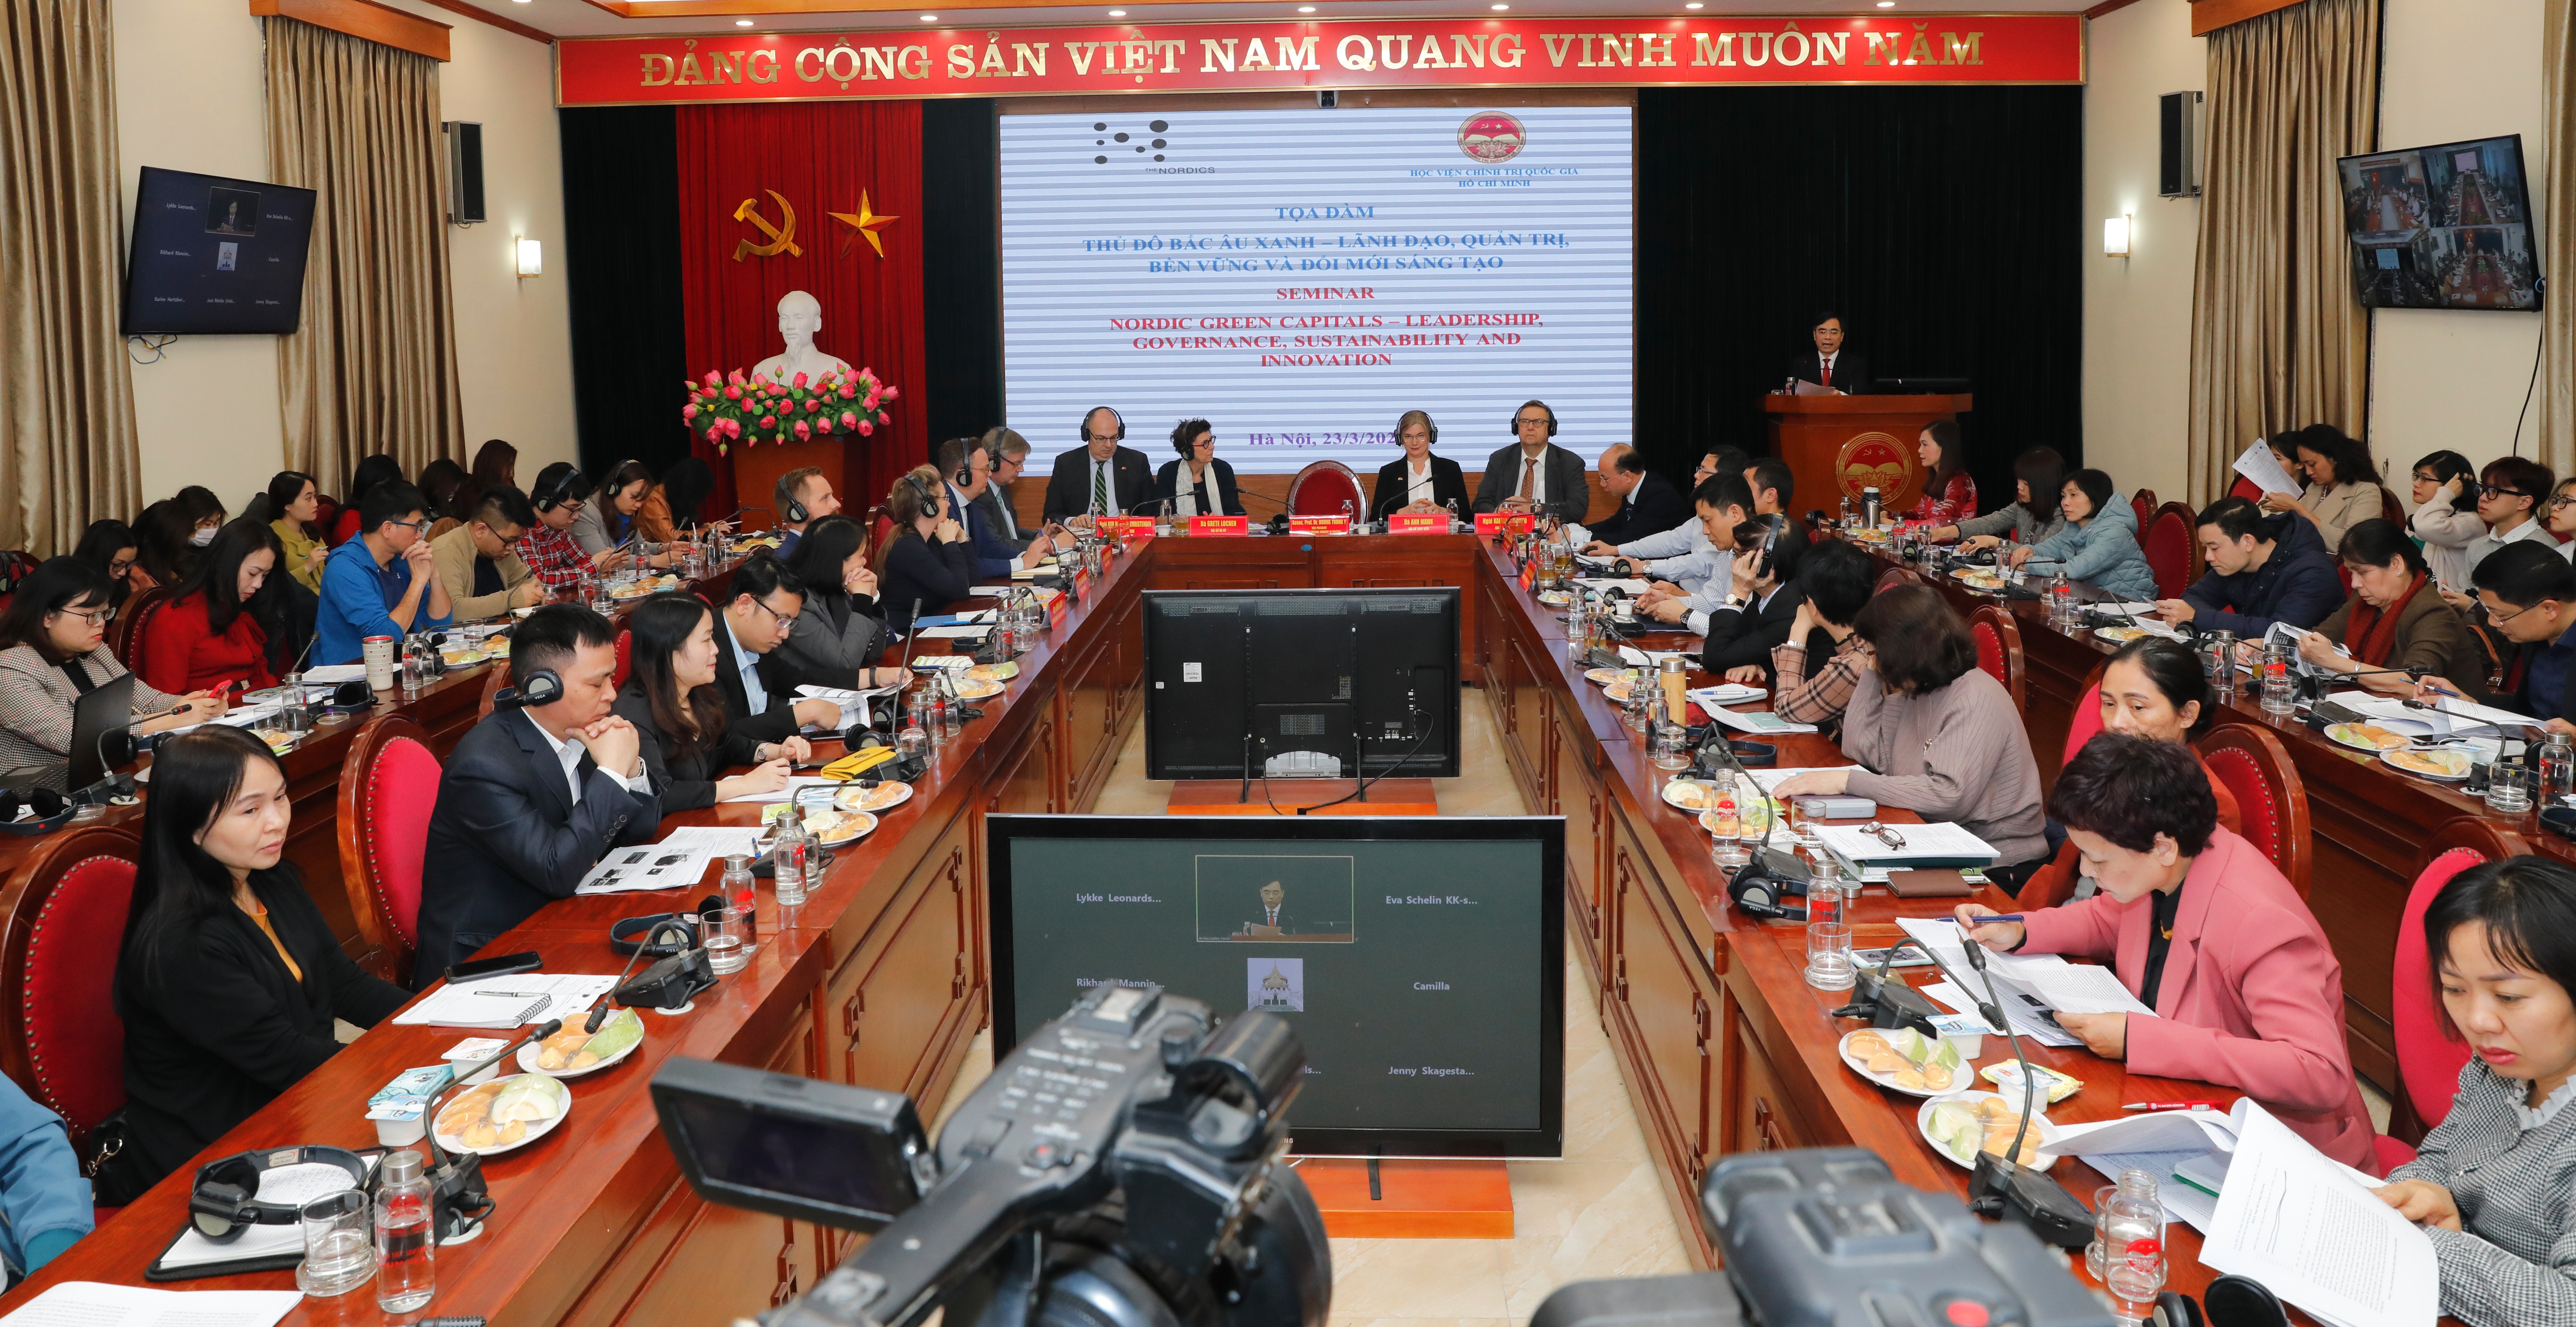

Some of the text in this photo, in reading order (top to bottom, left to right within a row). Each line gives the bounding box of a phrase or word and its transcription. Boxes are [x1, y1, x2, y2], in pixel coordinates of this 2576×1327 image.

[640, 21, 1985, 90] ĐẢNG CỘNG SẢN VIỆT NAM QUANG VINH MUÔN NĂM
[1437, 169, 1462, 177] VIỆN
[1504, 168, 1522, 177] TRỊ
[1525, 167, 1556, 176] QUỐC
[1478, 179, 1497, 187] CHÍ
[1275, 203, 1374, 222] TỌA ĐÀM
[1083, 236, 1126, 252] THỦ
[1133, 235, 1163, 251] ĐÔ
[1170, 235, 1213, 250] BẮC
[1220, 234, 1247, 249] ÂU
[1255, 236, 1314, 249] XANH
[1339, 233, 1397, 248] LÃNH
[1405, 235, 1455, 250] ĐẠO,
[1461, 230, 1521, 249] QUẢN
[1529, 233, 1569, 248] TRỊ,
[1150, 255, 1503, 273] BỀN VỮNG VÀ ĐỔI MỚI SÁNG TẠO
[1277, 287, 1375, 300] SEMINAR
[1110, 318, 1193, 330] NORDIC
[1201, 317, 1270, 328] GREEN
[1280, 316, 1382, 327] CAPITALS
[1407, 314, 1542, 326] LEADERSHIP,
[1134, 333, 1521, 348] GOVERNANCE, SUSTAINABILITY AND
[1261, 353, 1392, 367] INNOVATION
[1250, 433, 1392, 448] Hà Nội, 23/3/202
[1077, 893, 1161, 903] Lykke Leonards...
[1407, 896, 1441, 904] Schelin
[1446, 896, 1477, 904] KK-s...
[1076, 978, 1165, 988] Rikhar Mannin...
[1414, 982, 1449, 990] Camilla
[1388, 1067, 1474, 1076] Jenny Skagesta...
